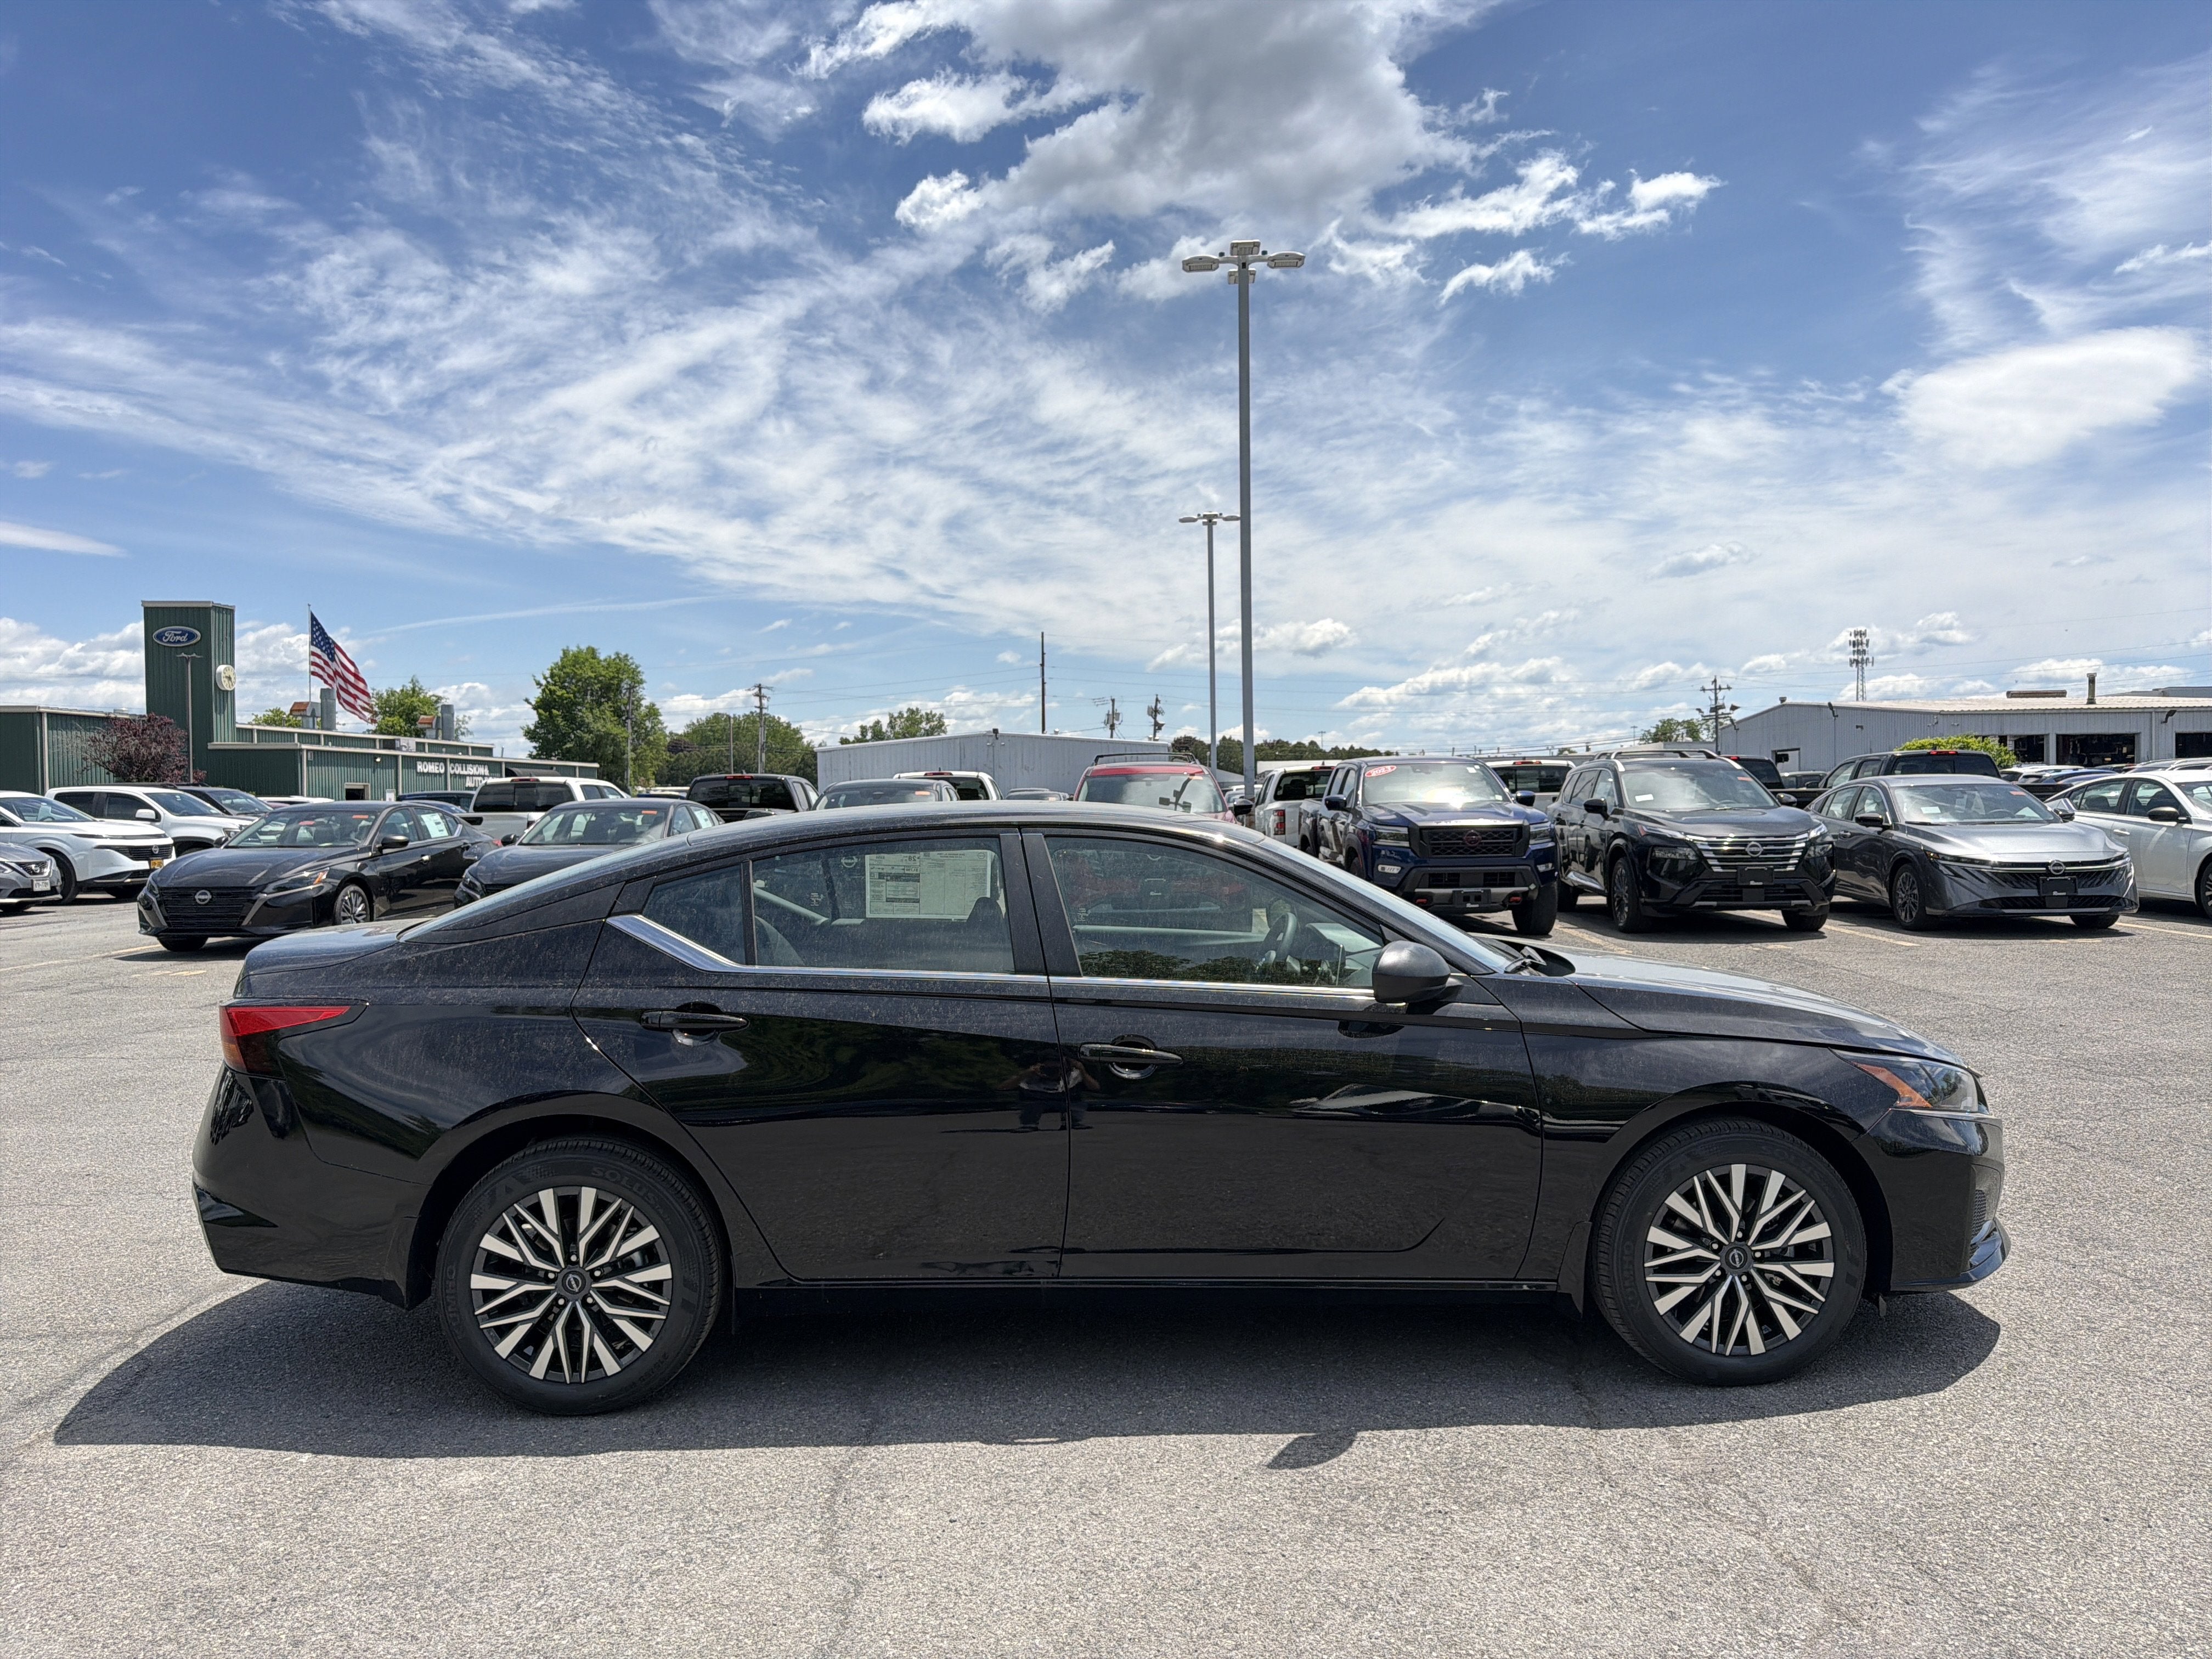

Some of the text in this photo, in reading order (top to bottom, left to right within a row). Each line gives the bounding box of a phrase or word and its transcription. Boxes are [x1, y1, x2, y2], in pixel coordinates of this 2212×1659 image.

[162, 630, 188, 642] Ford
[416, 761, 444, 774] ROMEO
[449, 763, 484, 775] COLLISION
[591, 1165, 659, 1206] SOLUS
